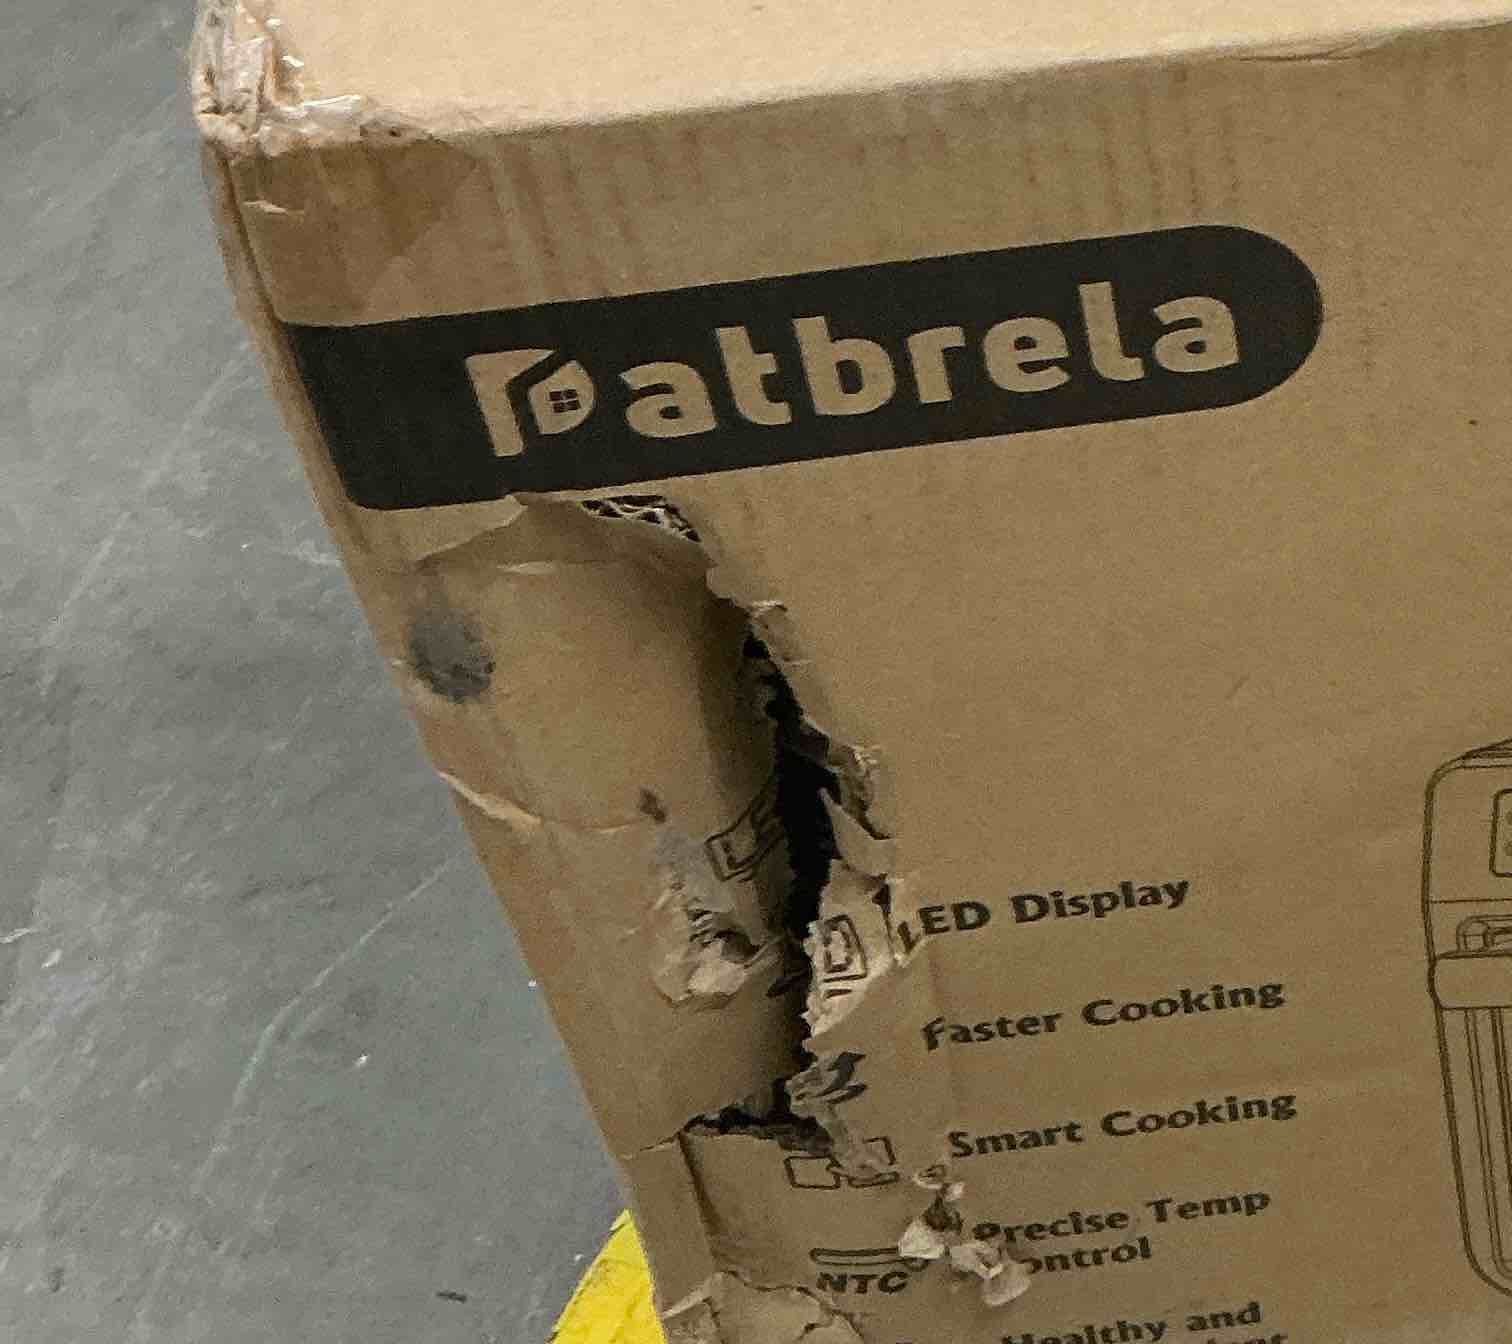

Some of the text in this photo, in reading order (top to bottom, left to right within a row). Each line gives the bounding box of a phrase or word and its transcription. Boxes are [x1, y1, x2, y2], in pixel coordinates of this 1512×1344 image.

[464, 281, 1239, 459] Patbrela
[1009, 879, 1190, 924] Display
[921, 982, 1287, 1053] Faster Cooking
[947, 1093, 1298, 1158] Smart Cooking
[1145, 1189, 1272, 1225] Temp
[1018, 1235, 1152, 1275] ontrol
[815, 1270, 910, 1296] NTC
[1185, 1300, 1264, 1334] and
